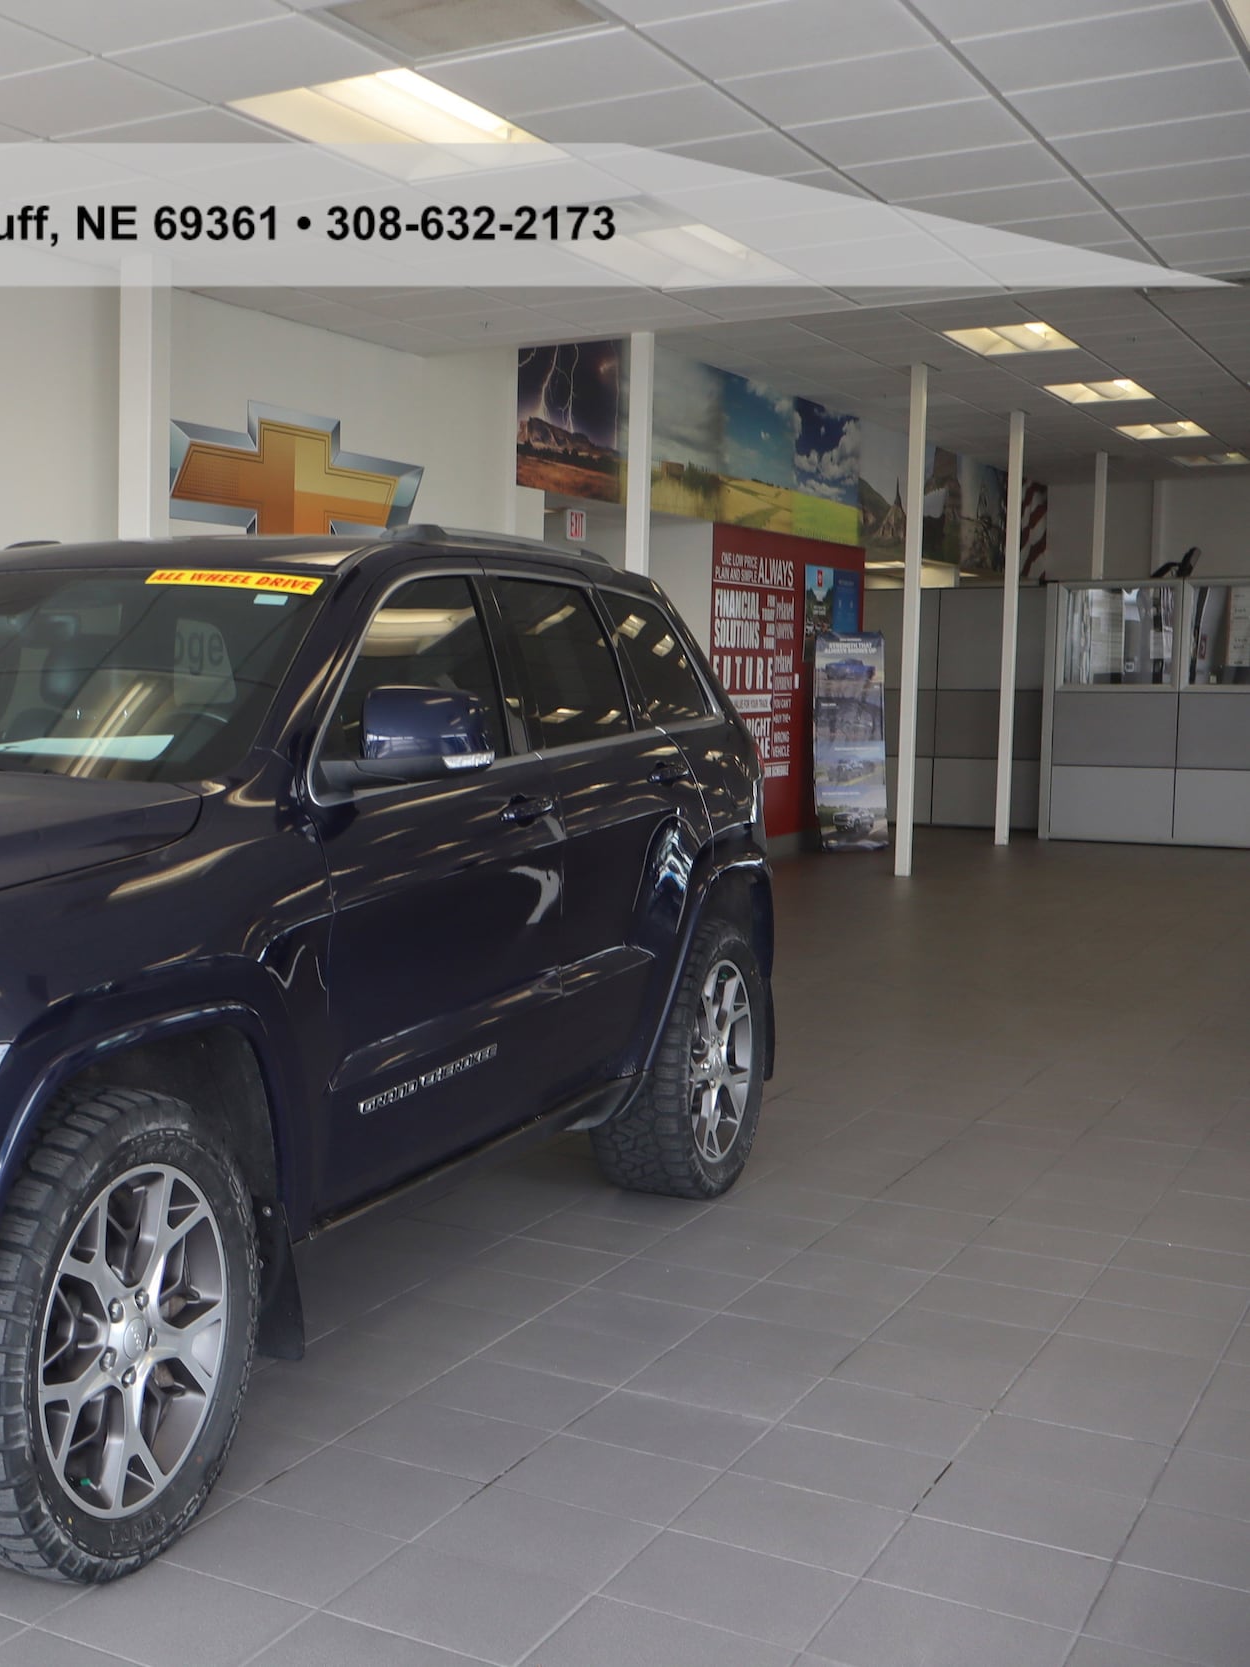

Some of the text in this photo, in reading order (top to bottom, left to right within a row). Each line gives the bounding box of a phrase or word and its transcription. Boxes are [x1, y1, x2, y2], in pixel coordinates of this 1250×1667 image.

[570, 511, 584, 538] EXIT
[715, 565, 730, 580] PLAIN
[730, 568, 741, 581] AND
[722, 552, 758, 569] ONE LOW PRICE
[758, 557, 794, 588] ALWAYS
[151, 572, 318, 590] ALL WHEEL DRIVE
[715, 588, 760, 620] FINANCIAL
[714, 618, 760, 649] SOLUTIONS
[713, 655, 773, 690] FUTURE
